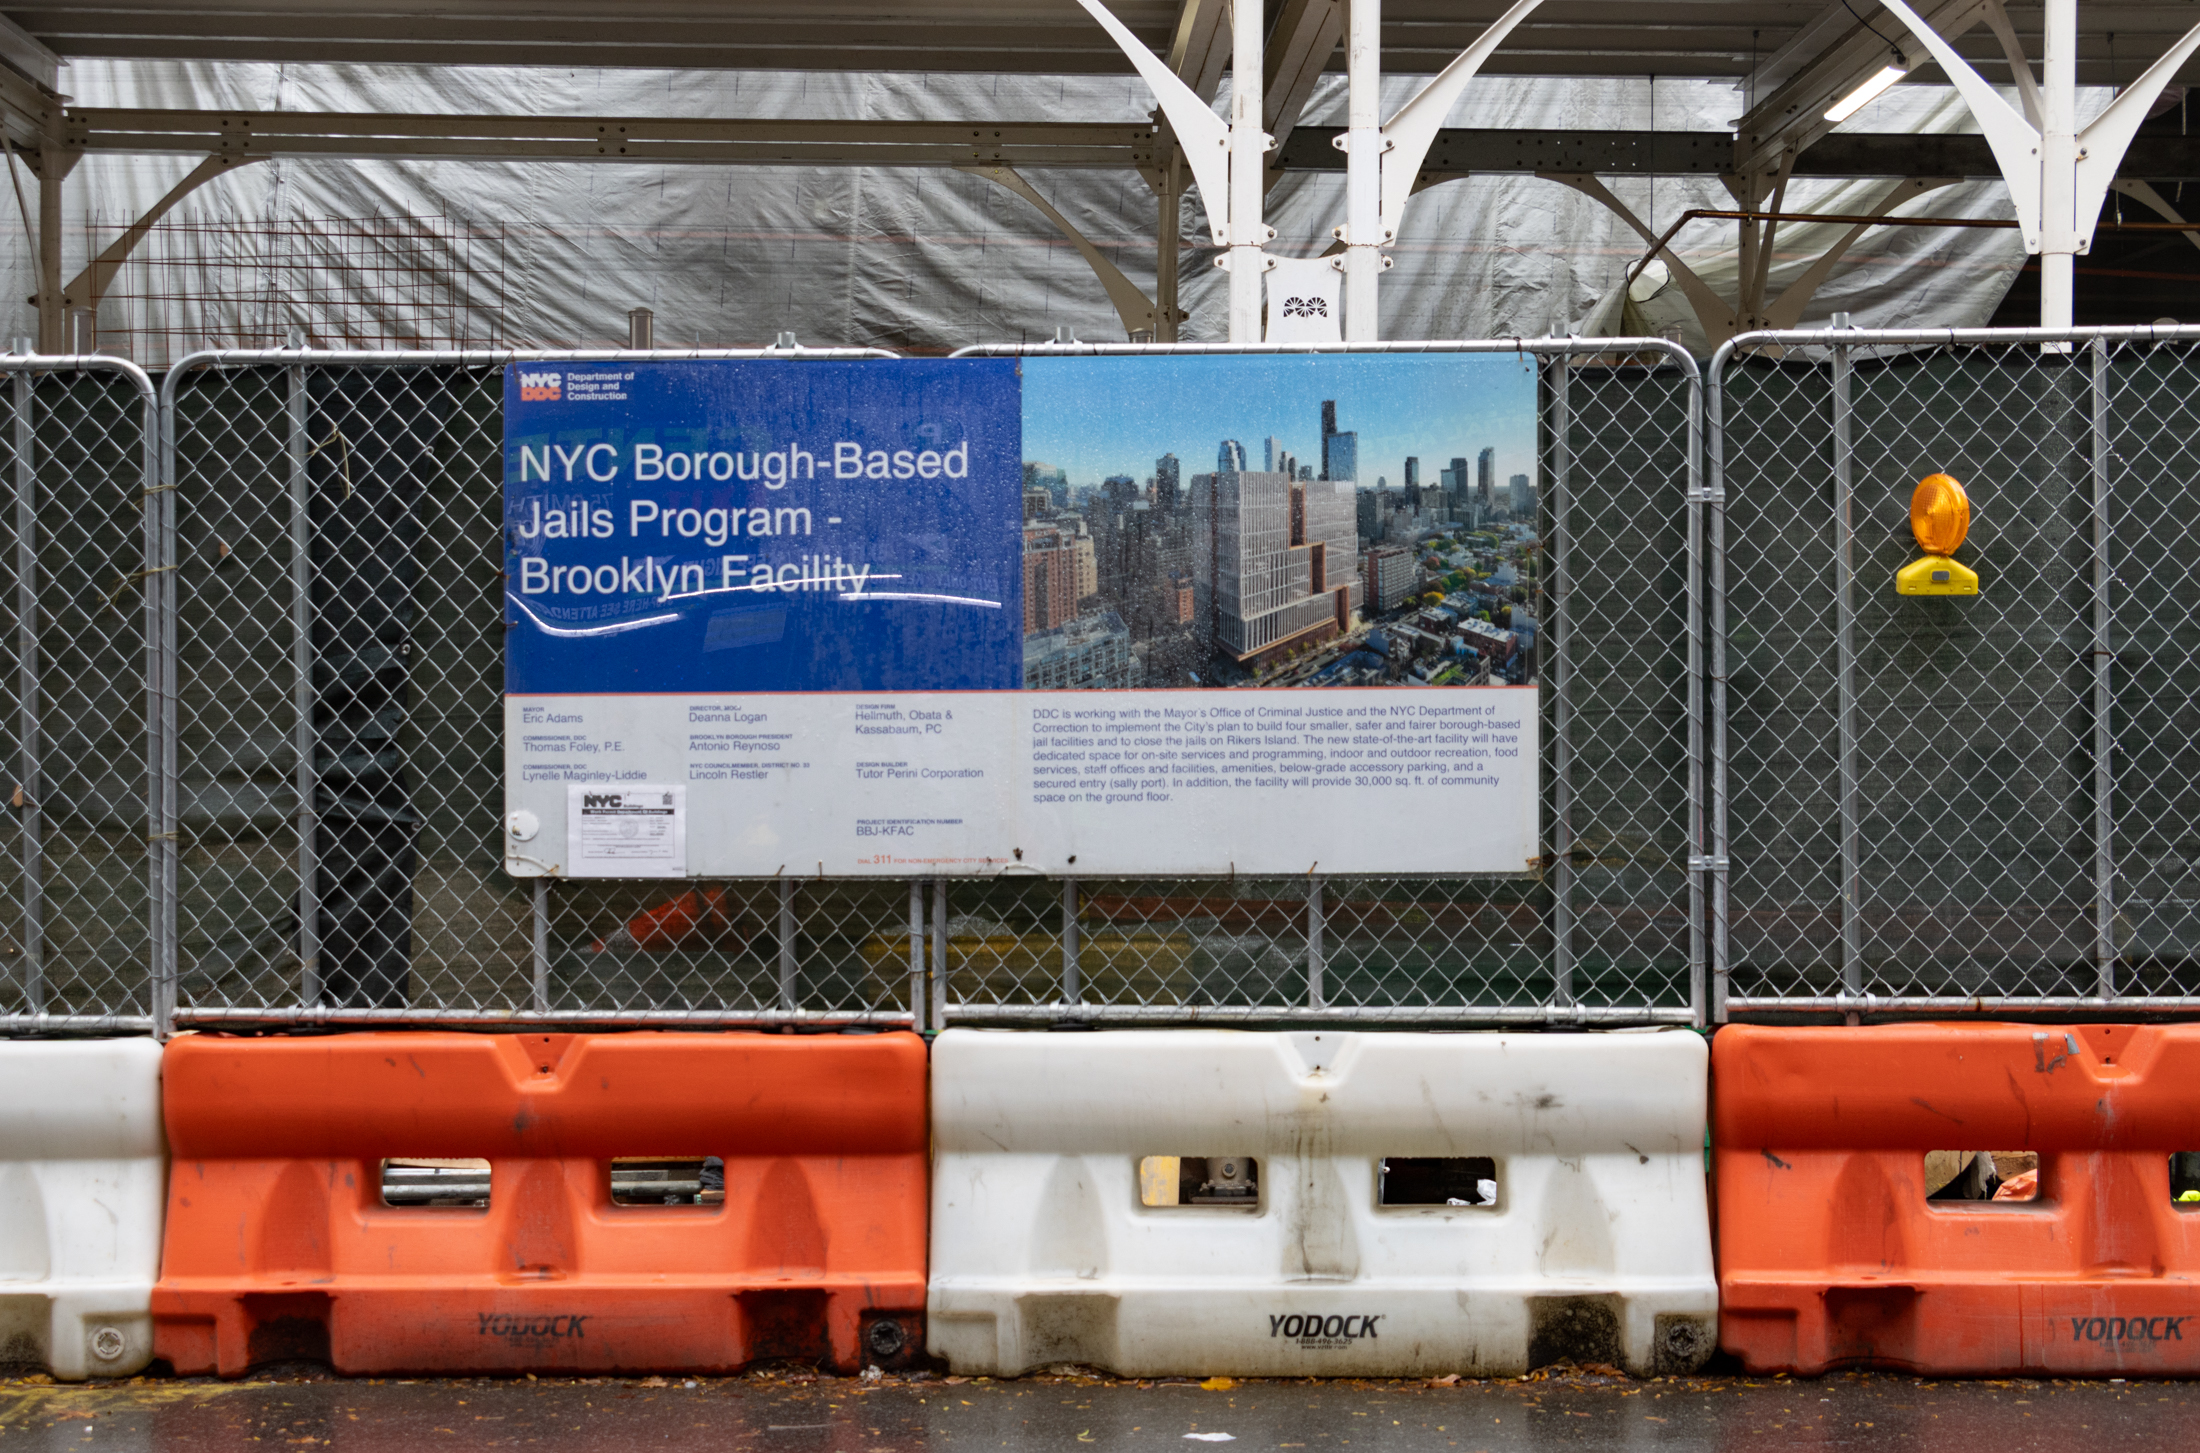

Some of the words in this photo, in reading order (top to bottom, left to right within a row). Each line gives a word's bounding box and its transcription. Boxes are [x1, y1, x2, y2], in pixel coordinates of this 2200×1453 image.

[520, 372, 562, 389] NYC
[566, 372, 623, 384] Department
[623, 371, 635, 381] of
[520, 386, 562, 401] DDC
[566, 381, 601, 393] Design
[601, 381, 620, 391] and
[566, 390, 628, 402] Construction
[521, 443, 618, 482] NYC
[635, 440, 968, 490] Borough-Based
[518, 500, 614, 539] Jails
[630, 500, 812, 547] Program
[521, 556, 705, 602] Brooklyn
[722, 554, 870, 600] Facility
[522, 712, 544, 724] Eric
[545, 712, 584, 724] Adams
[688, 711, 732, 724] Deanna
[733, 711, 768, 724] Logan
[854, 709, 906, 722] Hellmuth,
[908, 709, 943, 721] Obata
[944, 709, 954, 721] &
[1032, 708, 1060, 720] DDC
[1062, 708, 1072, 720] is
[1073, 708, 1117, 722] working
[1118, 708, 1142, 719] with
[1143, 708, 1162, 719] the
[1163, 707, 1208, 721] Mayor's
[1209, 706, 1242, 718] Office
[1244, 706, 1256, 718] of
[1257, 706, 1303, 718] Criminal
[1304, 706, 1344, 718] Justice
[1346, 706, 1368, 718] and
[1369, 705, 1388, 717] the
[1389, 705, 1416, 717] NYC
[1418, 705, 1483, 719] Department
[1484, 704, 1496, 716] of
[854, 724, 923, 736] Kassabaum,
[924, 722, 943, 735] PC
[1032, 722, 1089, 734] Correction
[1091, 722, 1103, 733] to
[1104, 722, 1162, 735] implement
[1163, 721, 1182, 732] the
[1184, 720, 1215, 734] City's
[1216, 721, 1241, 734] plan
[1242, 721, 1254, 732] to
[1256, 720, 1283, 732] build
[1284, 720, 1308, 732] four
[1309, 720, 1352, 732] smaller,
[1354, 719, 1383, 731] safer
[1384, 719, 1406, 731] and
[1408, 719, 1438, 731] fairer
[1438, 718, 1521, 733] borough-based
[522, 740, 567, 753] Thomas
[568, 740, 601, 754] Foley,
[604, 740, 625, 752] P.E.
[688, 740, 730, 752] Antonio
[732, 740, 781, 752] Reynoso
[1032, 736, 1048, 750] jail
[1050, 736, 1095, 748] facilities
[1096, 736, 1118, 747] and
[1120, 736, 1132, 747] to
[1133, 736, 1163, 747] close
[1164, 735, 1183, 746] the
[1184, 735, 1208, 749] jails
[1208, 736, 1224, 746] on
[1226, 734, 1262, 746] Rikers
[1264, 734, 1300, 746] Island.
[1302, 734, 1325, 746] The
[1326, 736, 1350, 745] new
[1352, 733, 1433, 745] state-of-the-art
[1434, 732, 1470, 746] facility
[1471, 732, 1489, 744] will
[1491, 732, 1519, 744] have
[1032, 750, 1086, 762] dedicated
[1088, 751, 1122, 763] space
[1123, 749, 1140, 761] for
[1140, 749, 1178, 761] on-site
[1180, 749, 1226, 760] services
[1228, 748, 1250, 760] and
[1252, 748, 1327, 762] programming,
[1329, 748, 1365, 759] indoor
[1366, 747, 1388, 759] and
[1389, 747, 1432, 759] outdoor
[1434, 746, 1492, 759] recreation,
[1494, 746, 1519, 758] food
[689, 769, 728, 780] Lincoln
[730, 768, 770, 780] Restler
[854, 767, 885, 780] Tutor
[886, 767, 918, 779] Perini
[920, 767, 984, 780] Corporation
[1032, 764, 1081, 776] services,
[1084, 763, 1108, 775] staff
[1109, 763, 1146, 775] offices
[1148, 763, 1169, 774] and
[1171, 762, 1218, 775] facilities,
[1220, 762, 1277, 774] amenities,
[1278, 762, 1347, 776] below-grade
[1349, 763, 1405, 775] accessory
[1406, 761, 1450, 774] parking,
[1452, 760, 1474, 772] and
[1476, 762, 1484, 772] a
[522, 770, 561, 784] Lynelle
[562, 769, 648, 783] Maginley-Liddie
[1032, 778, 1077, 790] secured
[1078, 778, 1107, 791] entry
[1109, 777, 1139, 791] (sally
[1140, 776, 1170, 790] port).
[1172, 777, 1184, 788] In
[1185, 776, 1232, 788] addition,
[1234, 776, 1252, 788] the
[1254, 776, 1290, 790] facility
[1291, 776, 1310, 787] will
[1311, 775, 1352, 789] provide
[1354, 775, 1393, 788] 30,000
[1394, 777, 1412, 788] sq.
[1414, 775, 1425, 786] ft.
[1427, 774, 1439, 786] of
[1440, 774, 1500, 788] community
[583, 794, 623, 808] NYC
[856, 818, 886, 826] PROJECT
[856, 824, 915, 837] BBJ-KFAC
[872, 854, 892, 865] 311
[892, 857, 908, 865] FOR
[908, 857, 962, 865] NON-EMERGENCY
[2071, 1316, 2185, 1341] YODOCK
